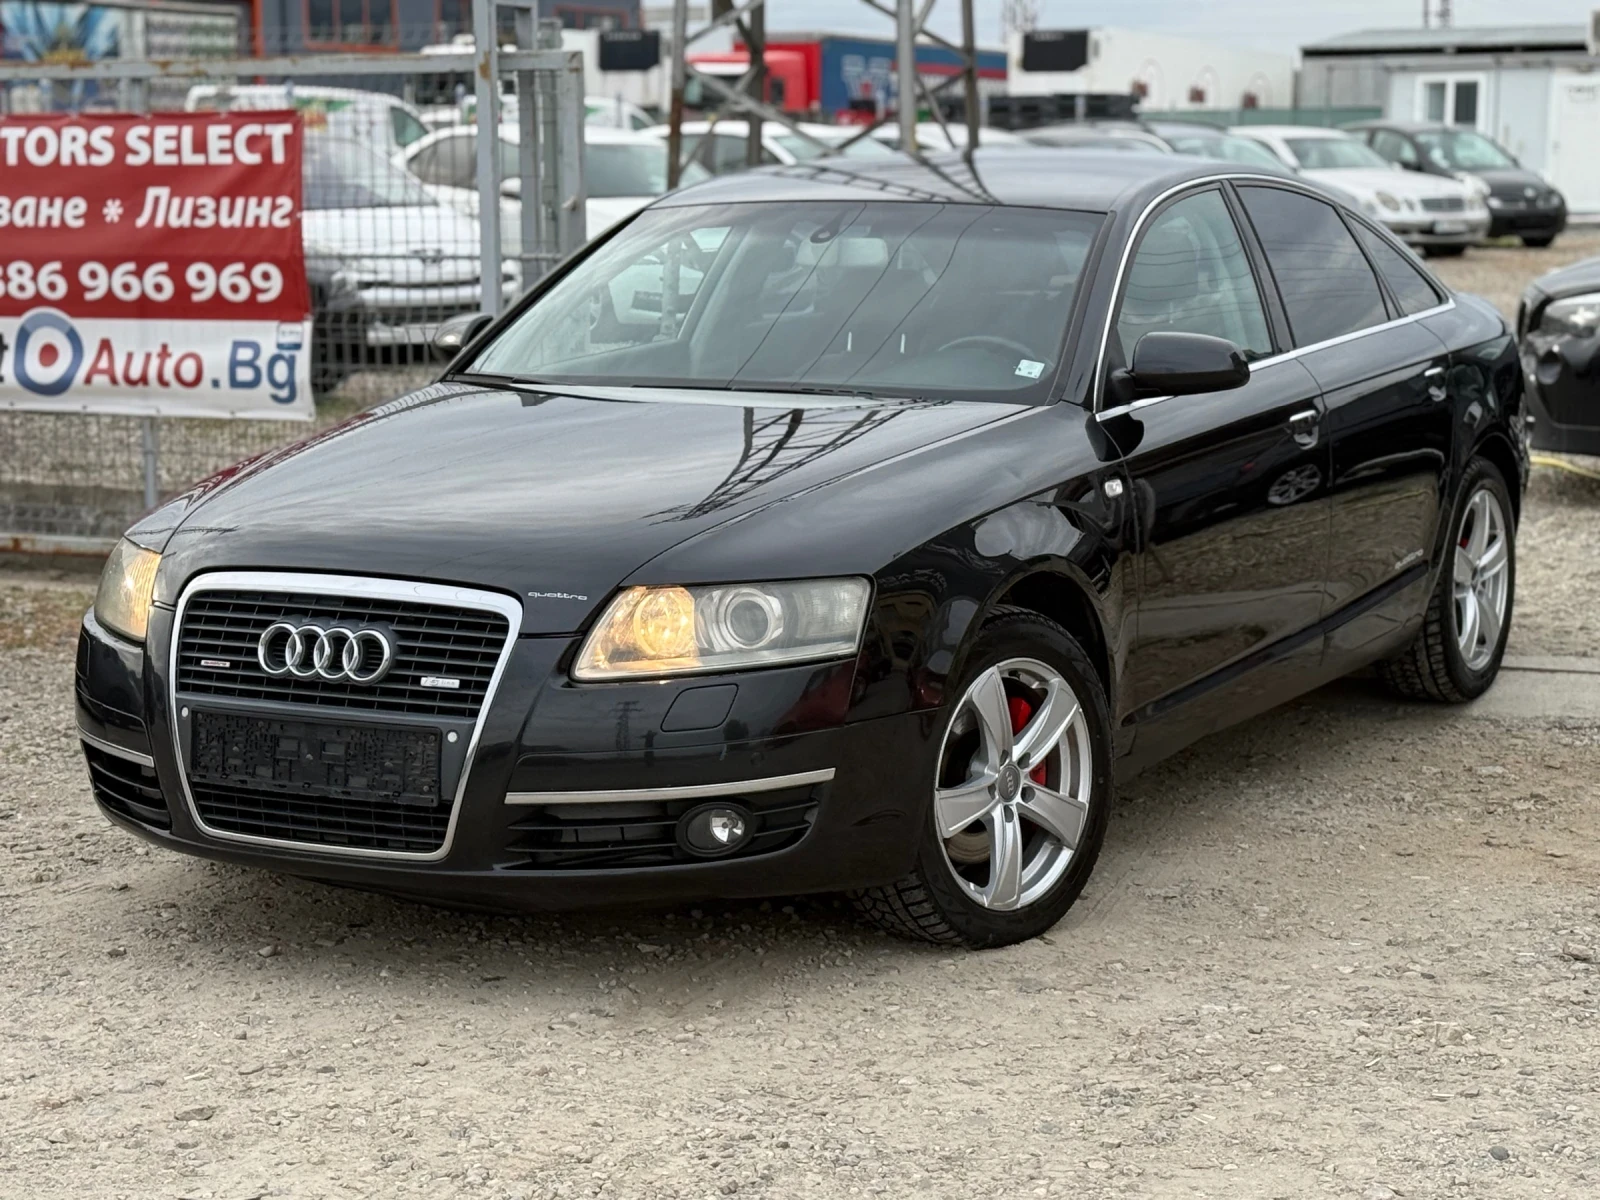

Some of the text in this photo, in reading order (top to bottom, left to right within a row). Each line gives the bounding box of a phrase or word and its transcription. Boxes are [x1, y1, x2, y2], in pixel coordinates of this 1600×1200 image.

[0, 123, 293, 167] TORS SELECT
[136, 186, 293, 229] Лизинг
[0, 260, 283, 303] 86 966 969
[527, 591, 588, 601] quattro
